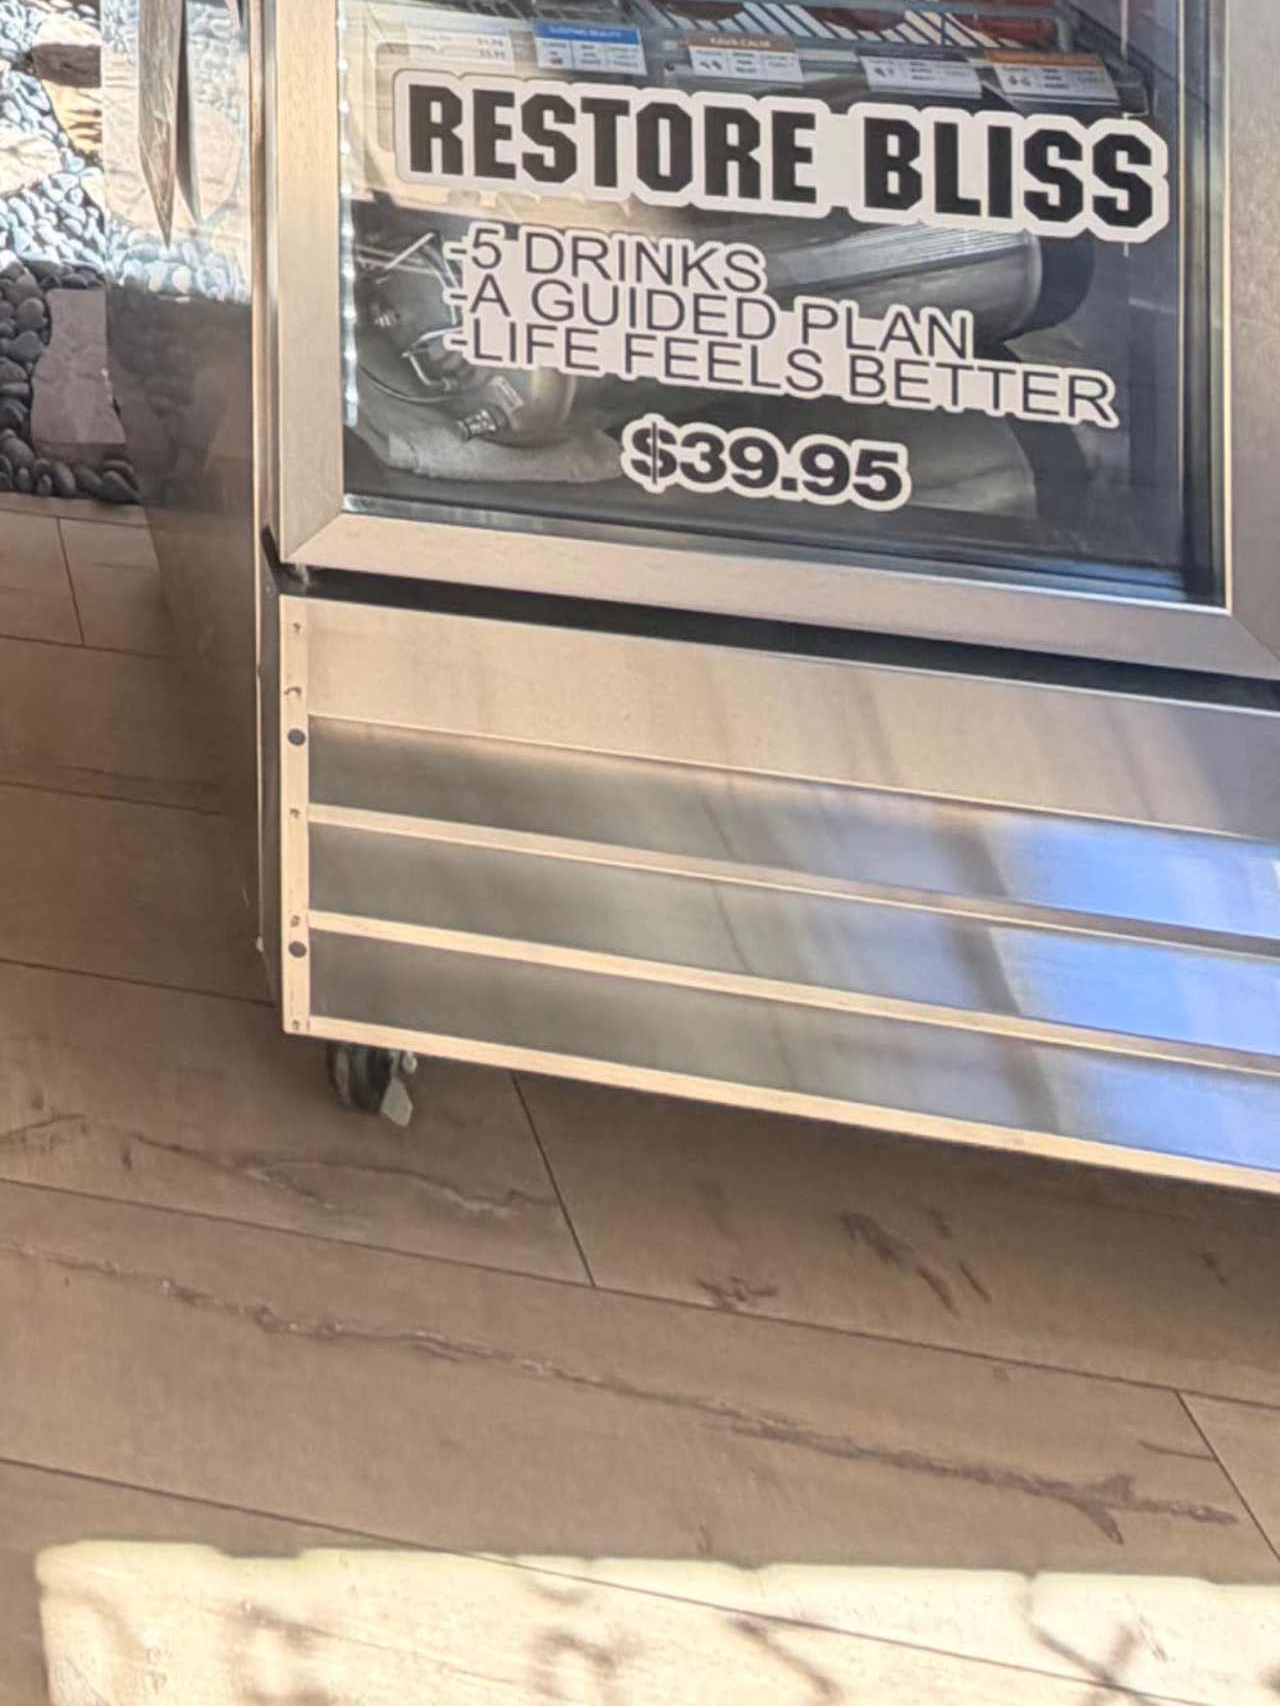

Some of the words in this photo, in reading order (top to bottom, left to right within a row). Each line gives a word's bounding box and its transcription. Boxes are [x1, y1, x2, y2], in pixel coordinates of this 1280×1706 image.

[408, 83, 819, 204] RESTORE
[864, 117, 1155, 231] BLISS
[451, 226, 503, 272] -5
[525, 231, 765, 295] DRINKS
[451, 274, 509, 318] -A
[532, 280, 776, 340] GUIDED
[801, 304, 971, 359] PLAN
[449, 321, 600, 372] -LIFE
[624, 331, 825, 394] FEELS
[849, 352, 1115, 425] BETTER
[631, 423, 904, 502] $39.95
